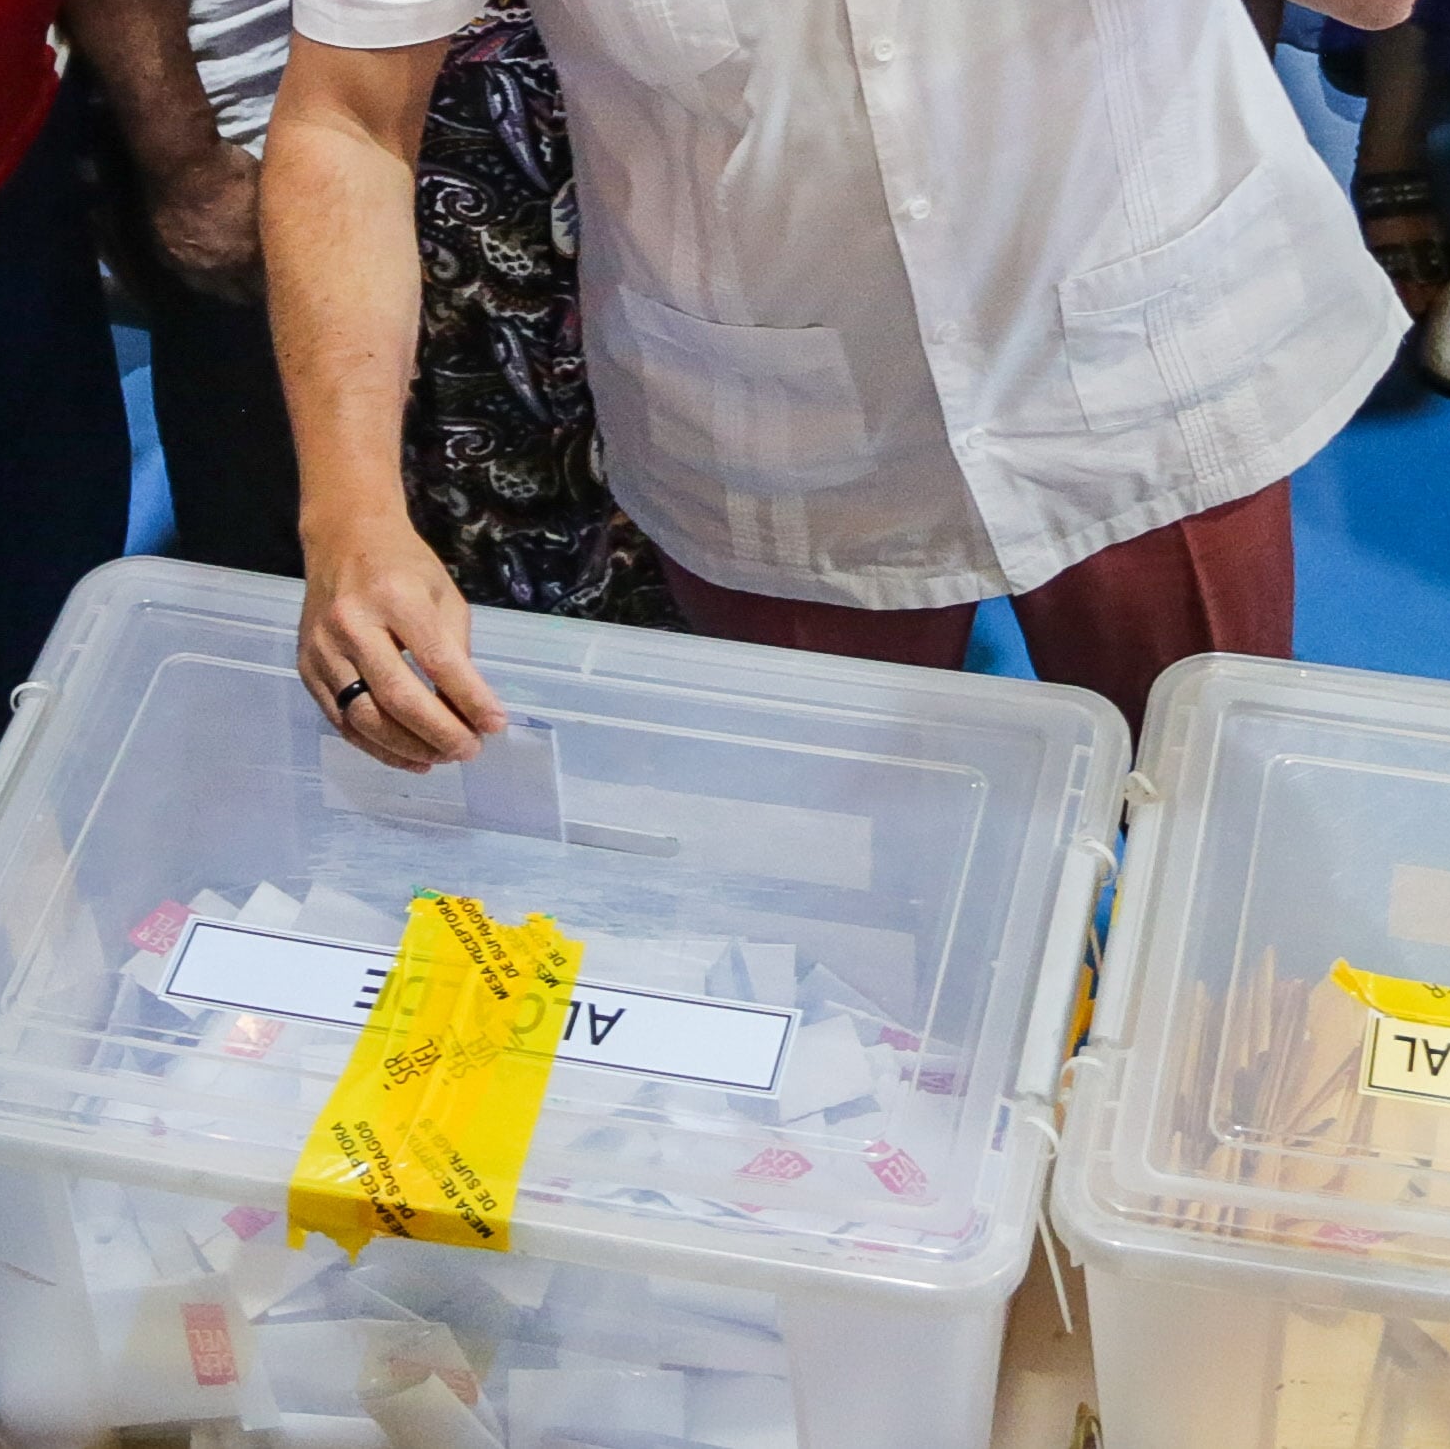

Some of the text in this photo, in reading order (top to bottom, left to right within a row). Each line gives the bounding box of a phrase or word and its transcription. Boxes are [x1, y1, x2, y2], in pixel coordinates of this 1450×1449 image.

[137, 927, 175, 951] SER
[480, 964, 511, 1000] MESA
[500, 961, 520, 979] DE
[354, 967, 627, 1047] ALCDE
[384, 1051, 421, 1086] SER
[455, 1197, 496, 1239] MESA
[474, 1189, 498, 1212] DE
